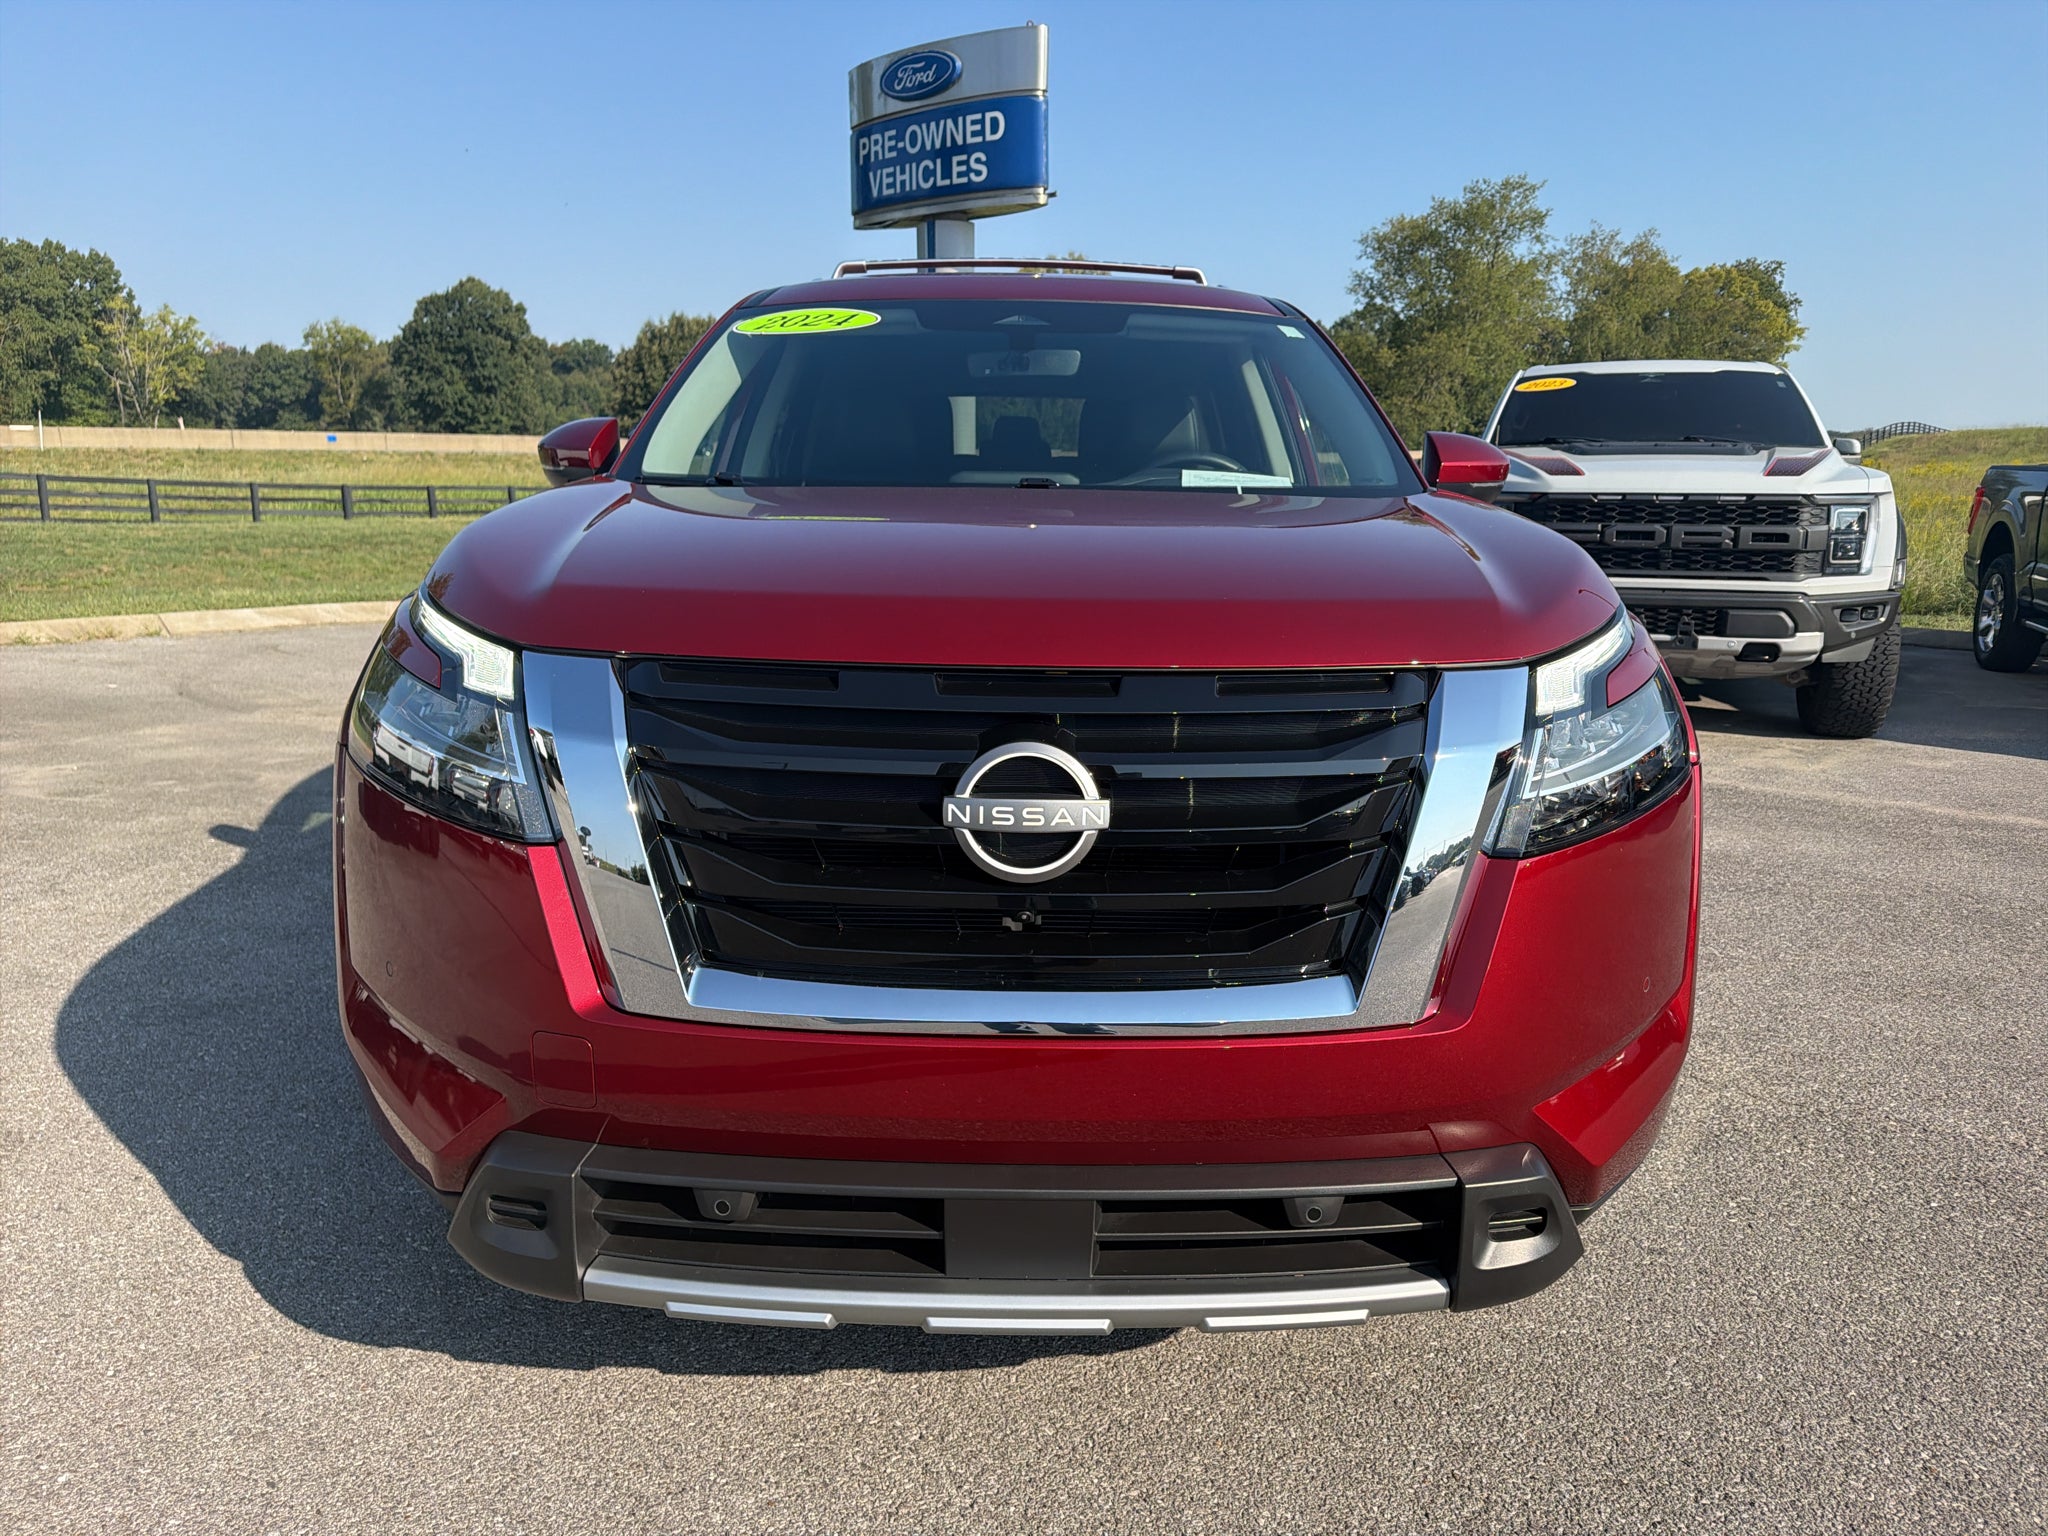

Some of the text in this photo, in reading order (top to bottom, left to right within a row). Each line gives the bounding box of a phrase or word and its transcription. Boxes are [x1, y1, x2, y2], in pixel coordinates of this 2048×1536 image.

[894, 61, 937, 90] Ford
[859, 110, 1005, 165] PRE-OWNED
[869, 152, 988, 198] VEHICLES
[754, 313, 860, 330] 2024
[947, 803, 1104, 826] NISSAN
